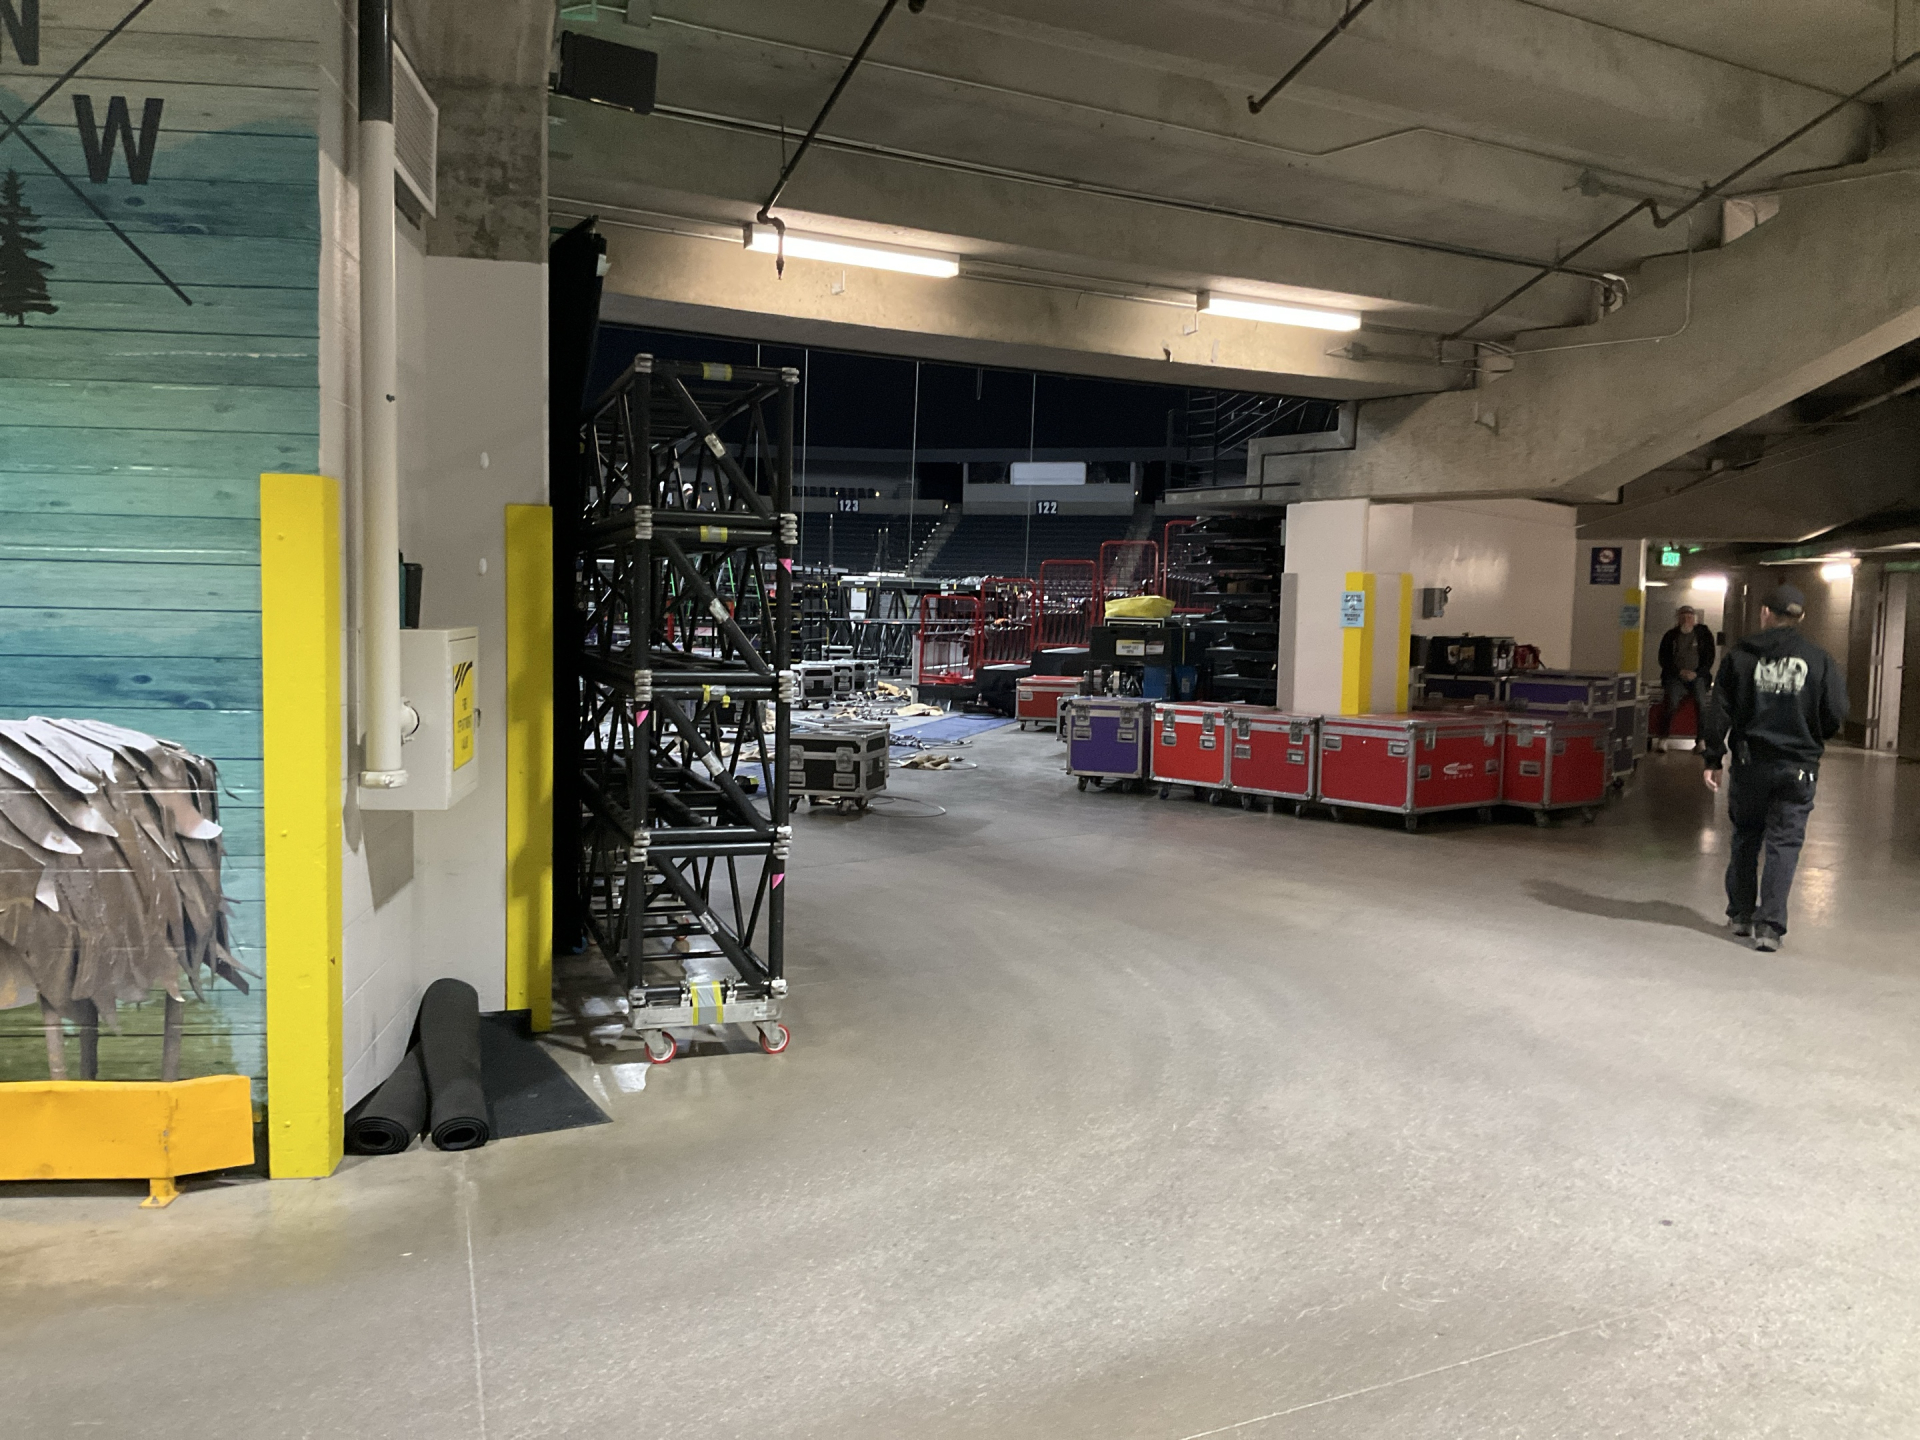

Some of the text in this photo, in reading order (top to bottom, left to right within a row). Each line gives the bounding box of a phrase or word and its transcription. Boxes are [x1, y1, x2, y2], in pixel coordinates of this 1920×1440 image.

[72, 94, 164, 185] W
[839, 499, 859, 512] 123
[1037, 501, 1057, 514] 122
